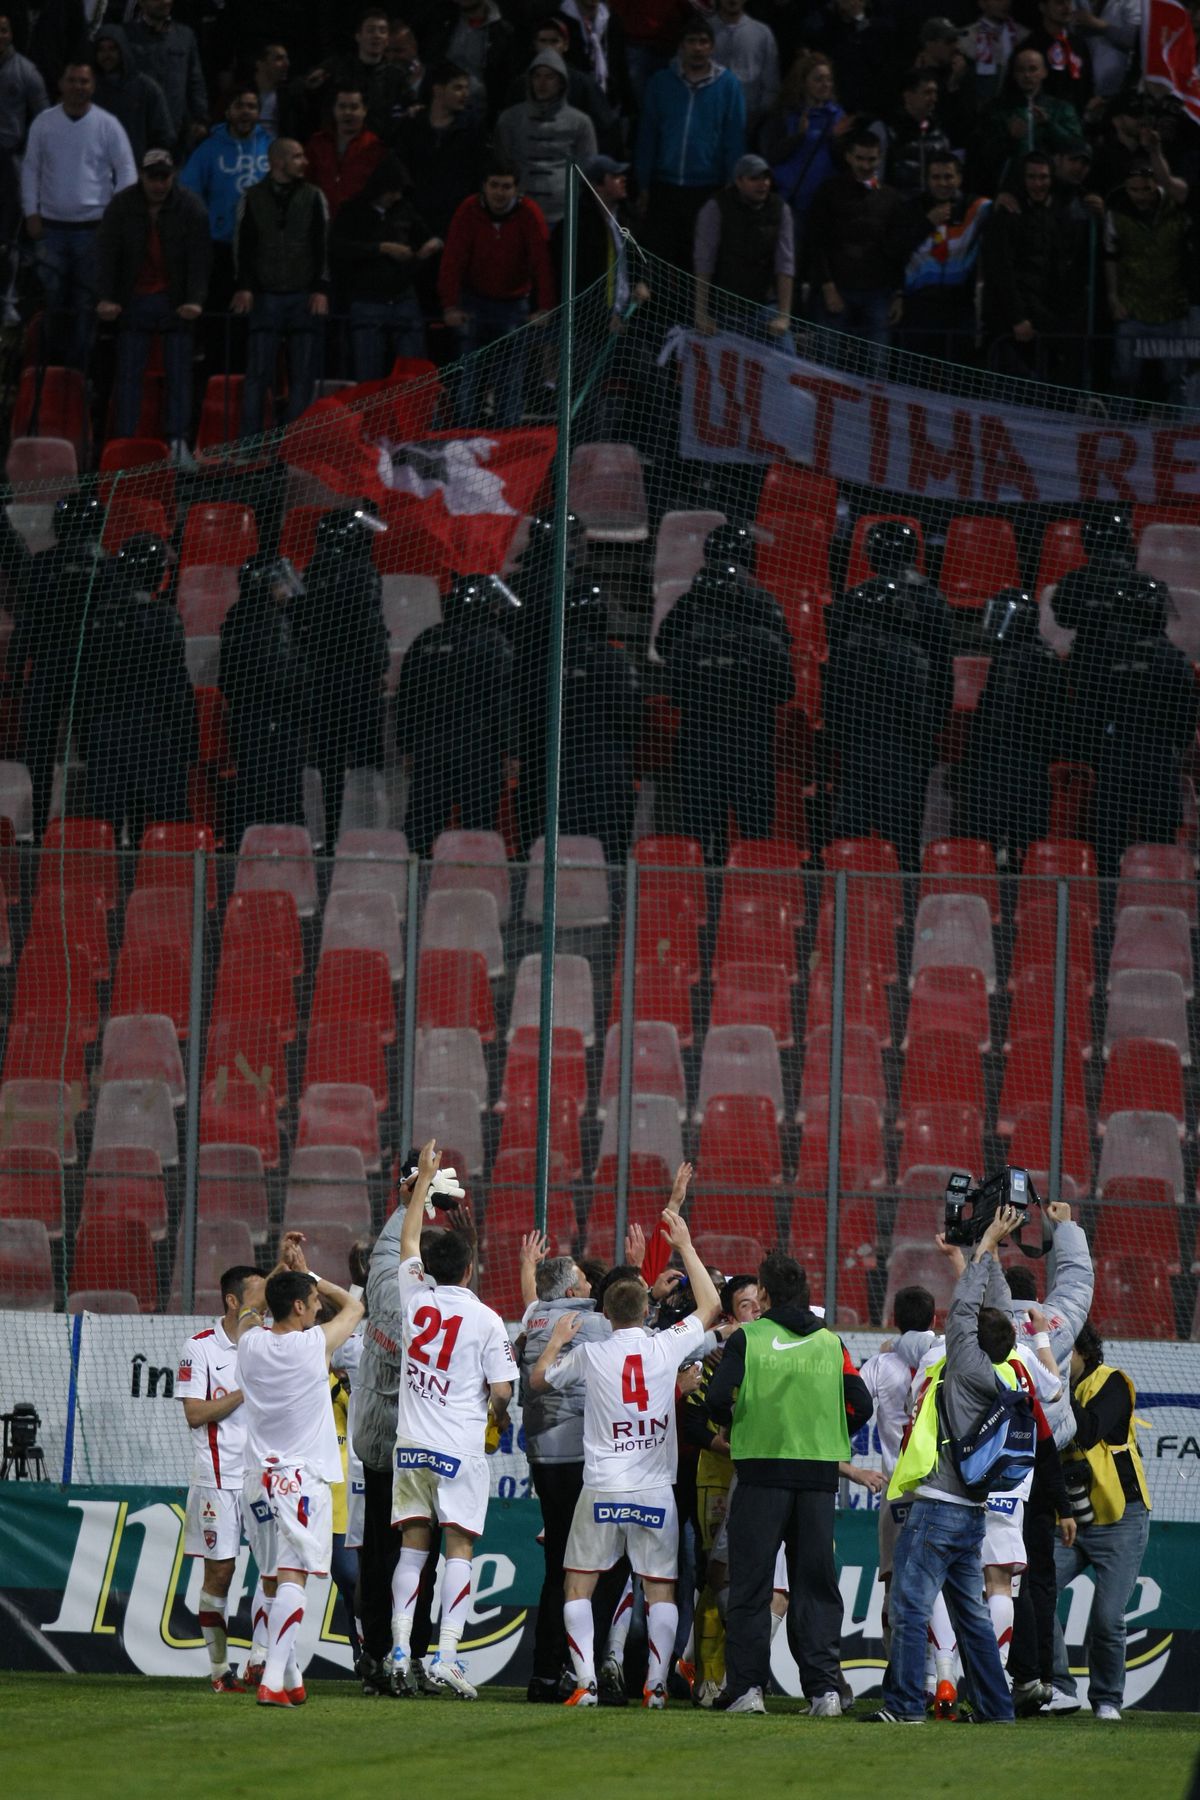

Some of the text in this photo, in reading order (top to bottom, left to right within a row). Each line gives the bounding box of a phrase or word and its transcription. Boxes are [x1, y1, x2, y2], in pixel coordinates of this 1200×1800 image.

[408, 1305, 463, 1372] 21
[622, 1353, 649, 1412] 4
[612, 1414, 669, 1439] RIN
[400, 1452, 454, 1472] DV24.ro
[598, 1508, 660, 1524] DV24.ro
